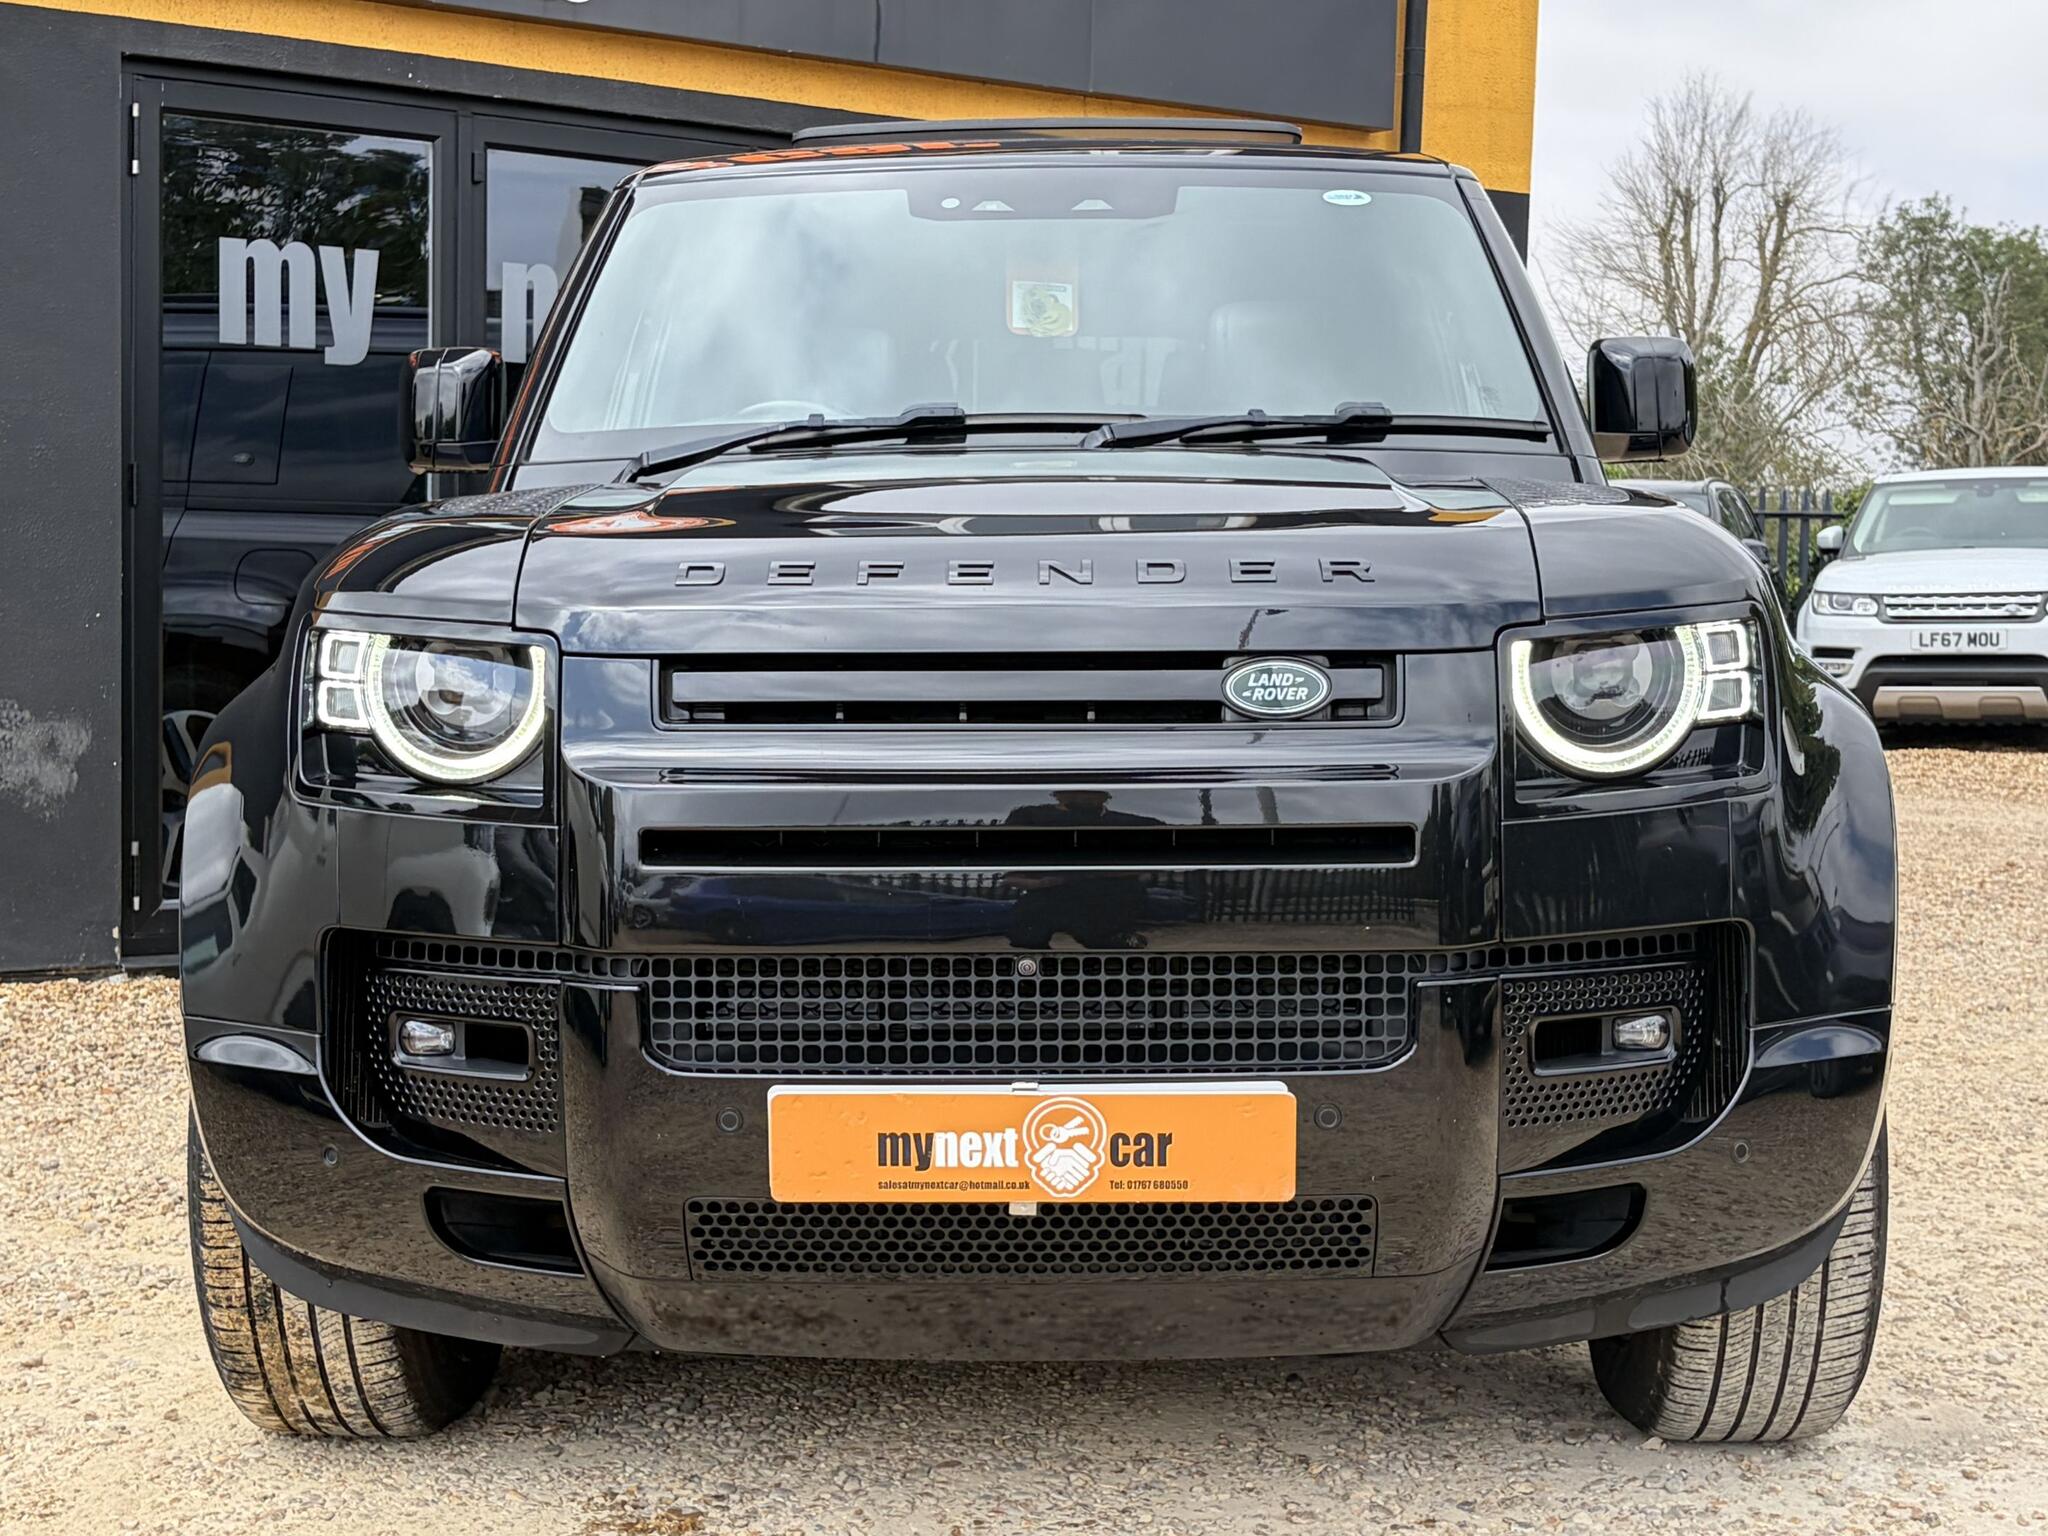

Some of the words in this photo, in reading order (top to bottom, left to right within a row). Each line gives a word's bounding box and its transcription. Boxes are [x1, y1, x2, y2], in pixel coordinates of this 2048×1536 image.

[218, 236, 380, 365] my
[674, 557, 1377, 587] DEFENDER
[1919, 631, 1963, 648] LF67
[1967, 631, 2000, 648] MOU
[1247, 673, 1294, 687] LAND
[1251, 687, 1309, 701] ROVER
[1109, 1131, 1173, 1168] car
[1109, 1180, 1125, 1190] Tel:
[1126, 1180, 1152, 1190] 01767
[1153, 1180, 1189, 1190] 680550
